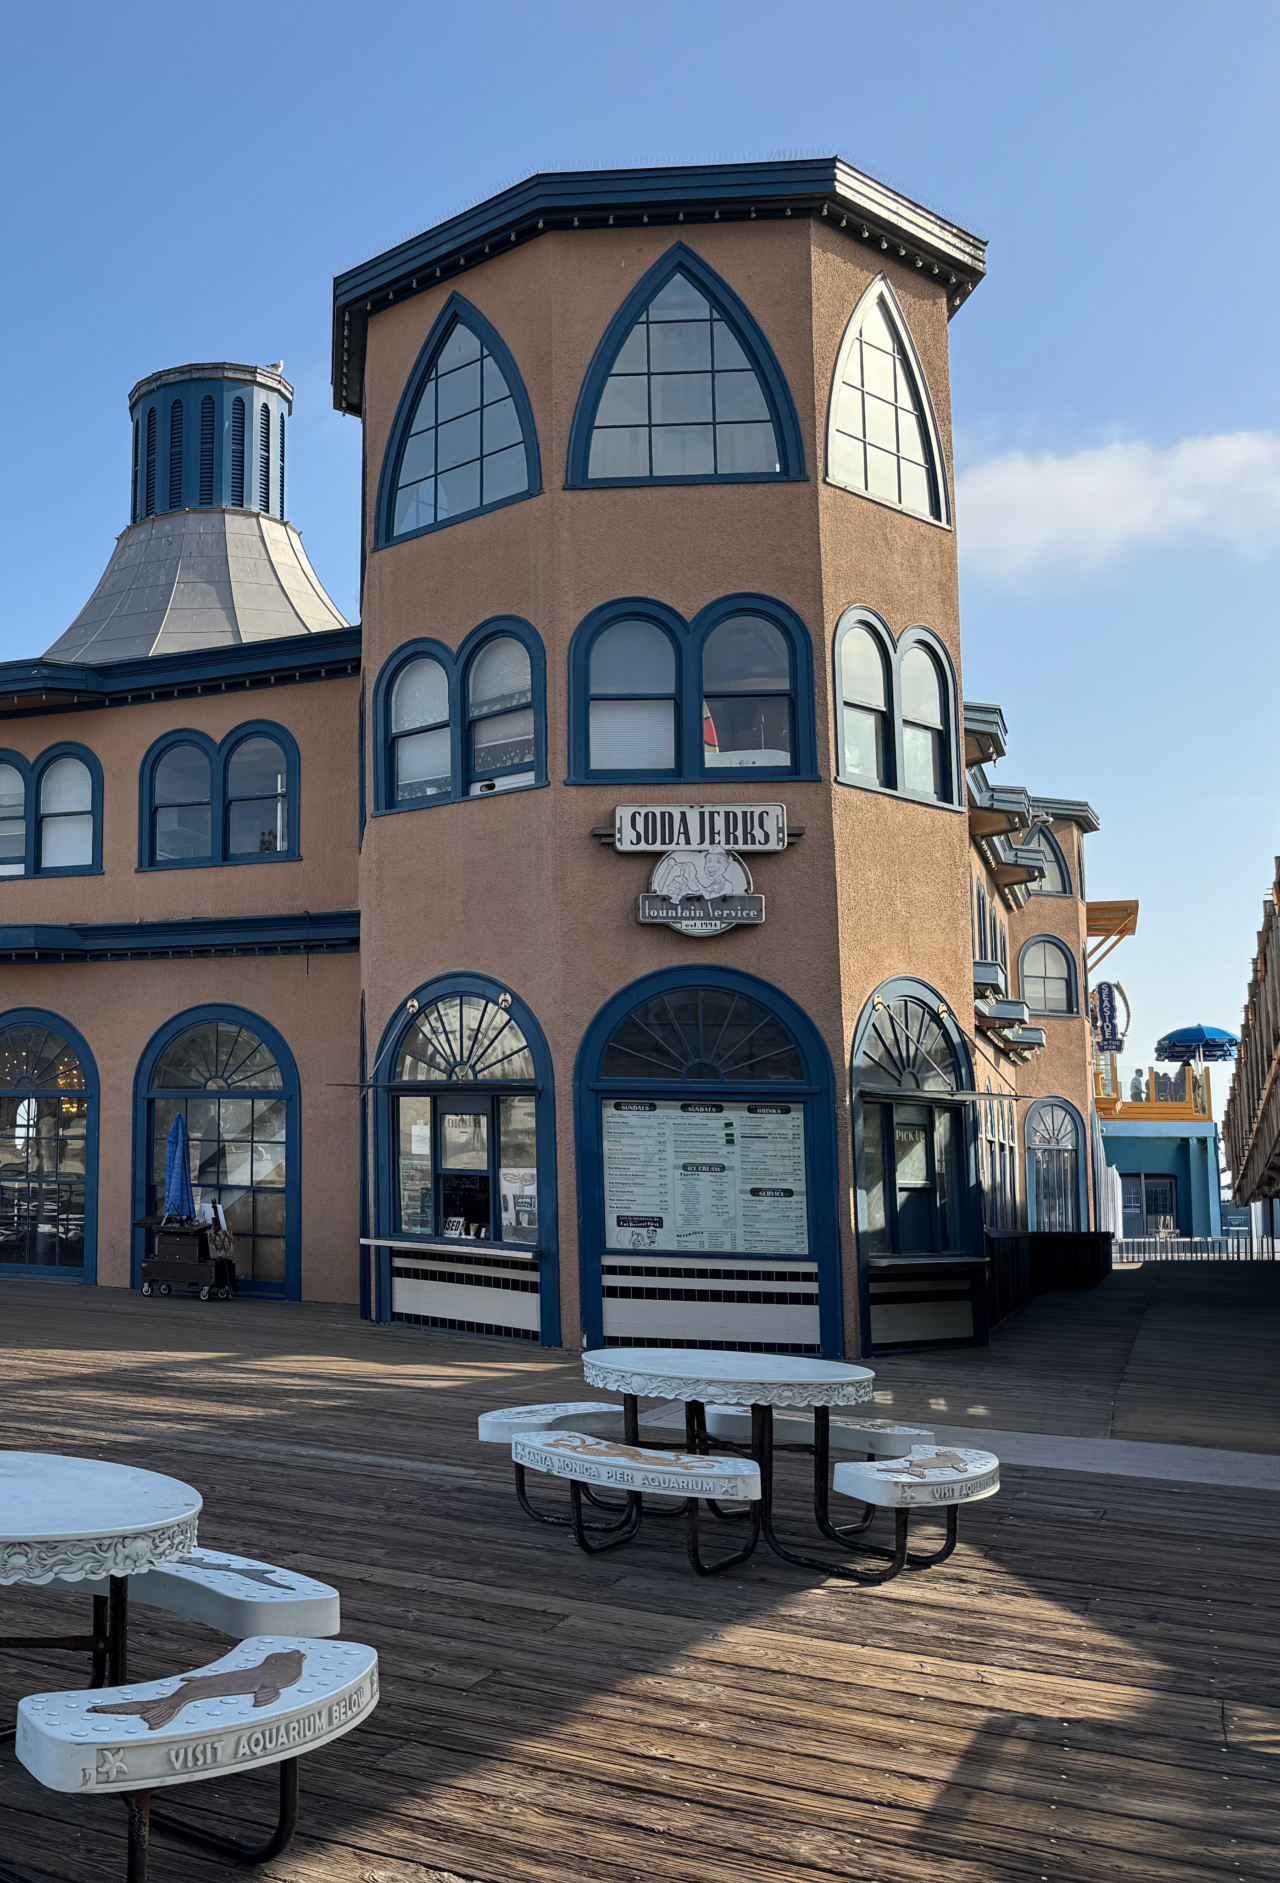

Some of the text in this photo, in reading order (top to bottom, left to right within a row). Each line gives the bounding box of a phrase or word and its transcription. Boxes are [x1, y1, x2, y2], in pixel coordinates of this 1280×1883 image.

[630, 811, 770, 846] SODA JERKS
[645, 900, 758, 917] Fountain Service
[1101, 984, 1112, 1039] SEASIDE
[896, 1129, 926, 1142] PICK UP
[524, 1449, 715, 1492] SANTA MONICA PIER AQUARIUM
[932, 1485, 958, 1499] VISIT
[170, 1687, 366, 1770] VISIT AQUARIUM BELOW
